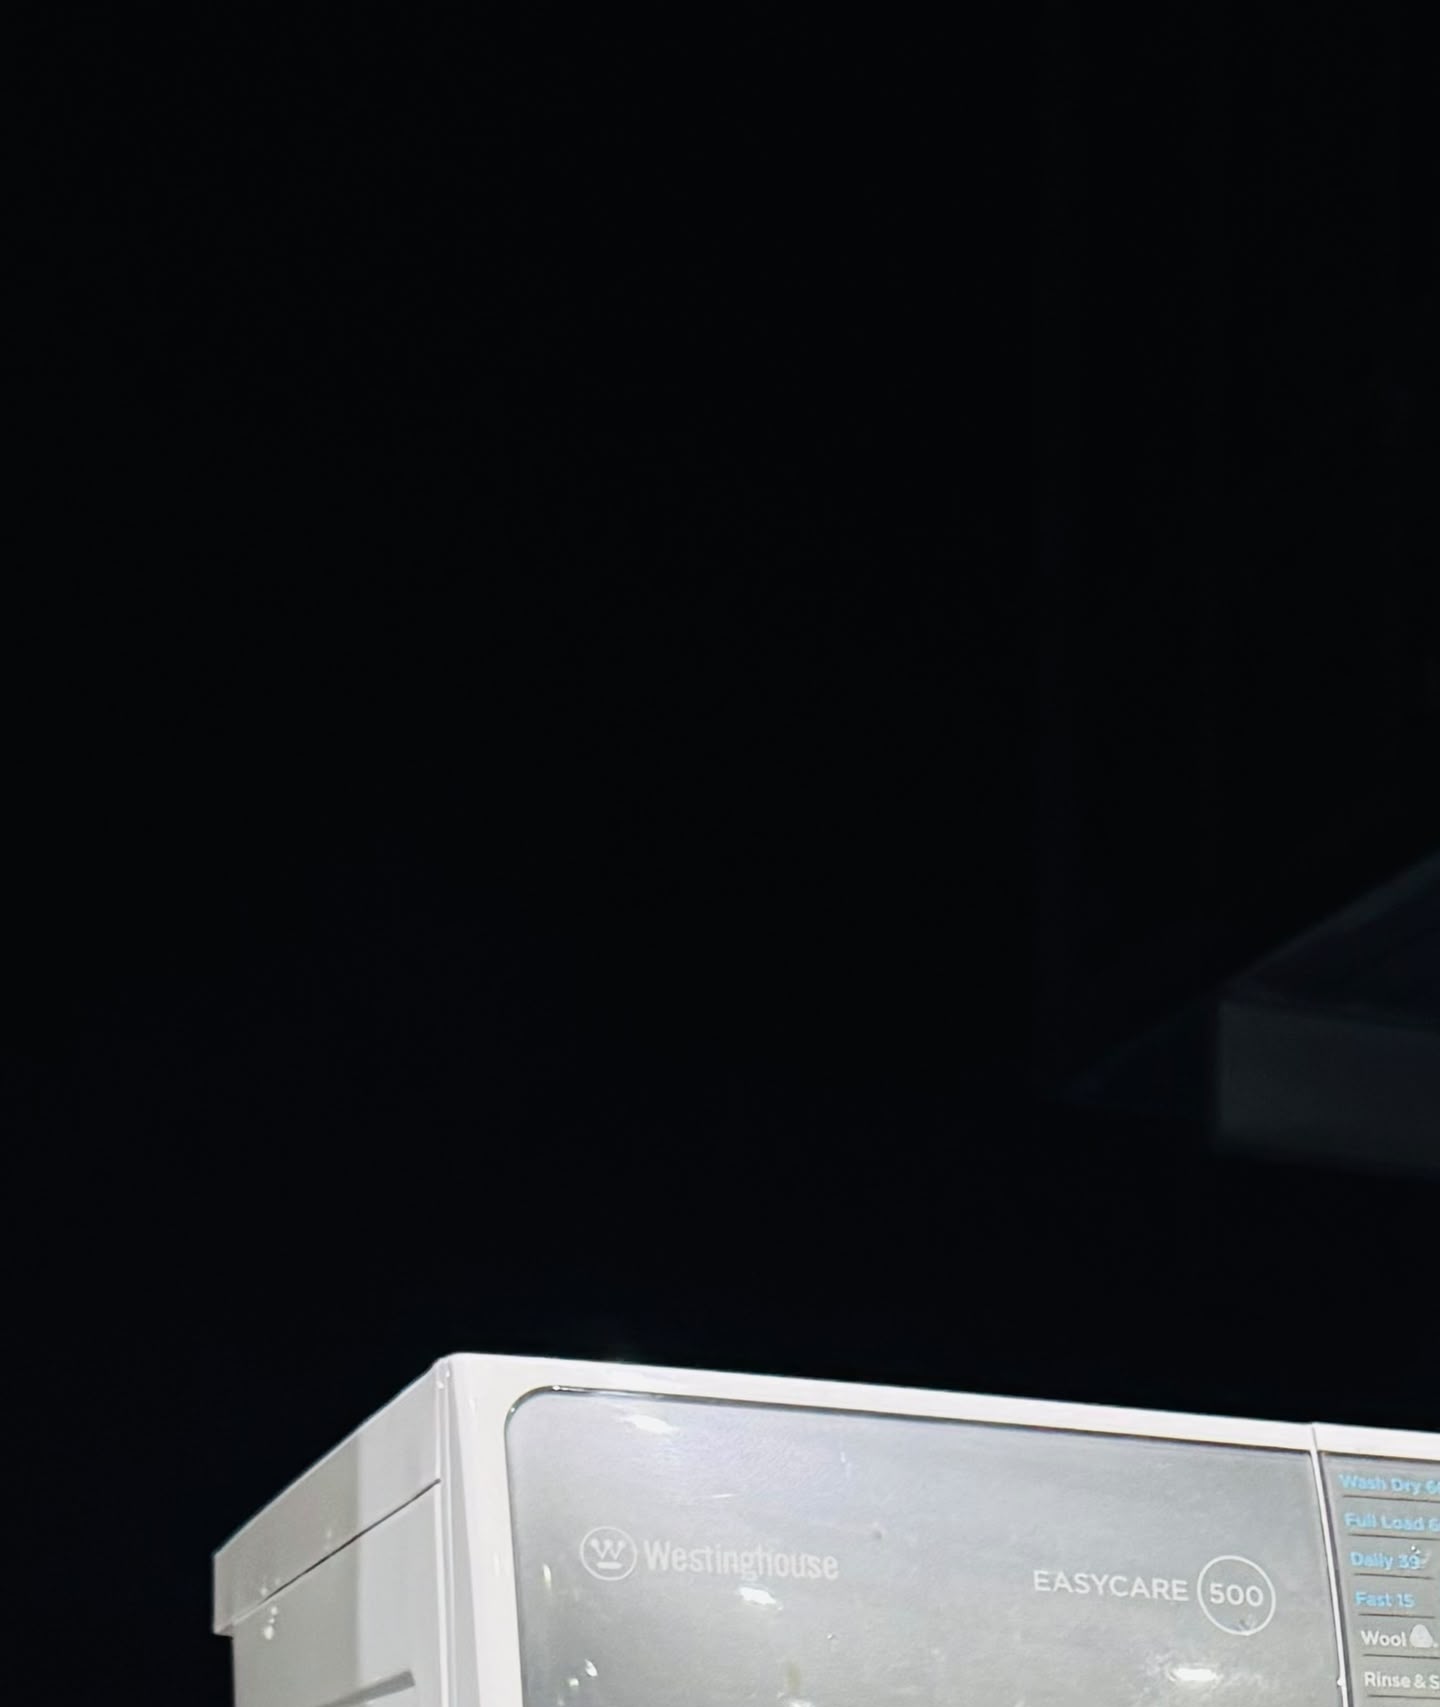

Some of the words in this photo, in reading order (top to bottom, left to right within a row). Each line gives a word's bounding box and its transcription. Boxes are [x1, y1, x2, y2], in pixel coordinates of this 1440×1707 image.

[1340, 1474, 1386, 1491] Wash
[1391, 1477, 1421, 1495] Dry
[1344, 1513, 1377, 1529] Full
[1382, 1515, 1423, 1531] Load
[643, 1539, 840, 1580] Westinghouse
[1350, 1552, 1393, 1569] Daily
[1033, 1569, 1189, 1601] EASYCARE
[1209, 1582, 1264, 1607] 500
[1355, 1591, 1393, 1607] Fast
[1397, 1593, 1415, 1608] 15
[1360, 1629, 1407, 1647] Wool
[1364, 1671, 1411, 1688] Rinse
[1414, 1673, 1427, 1689] &
